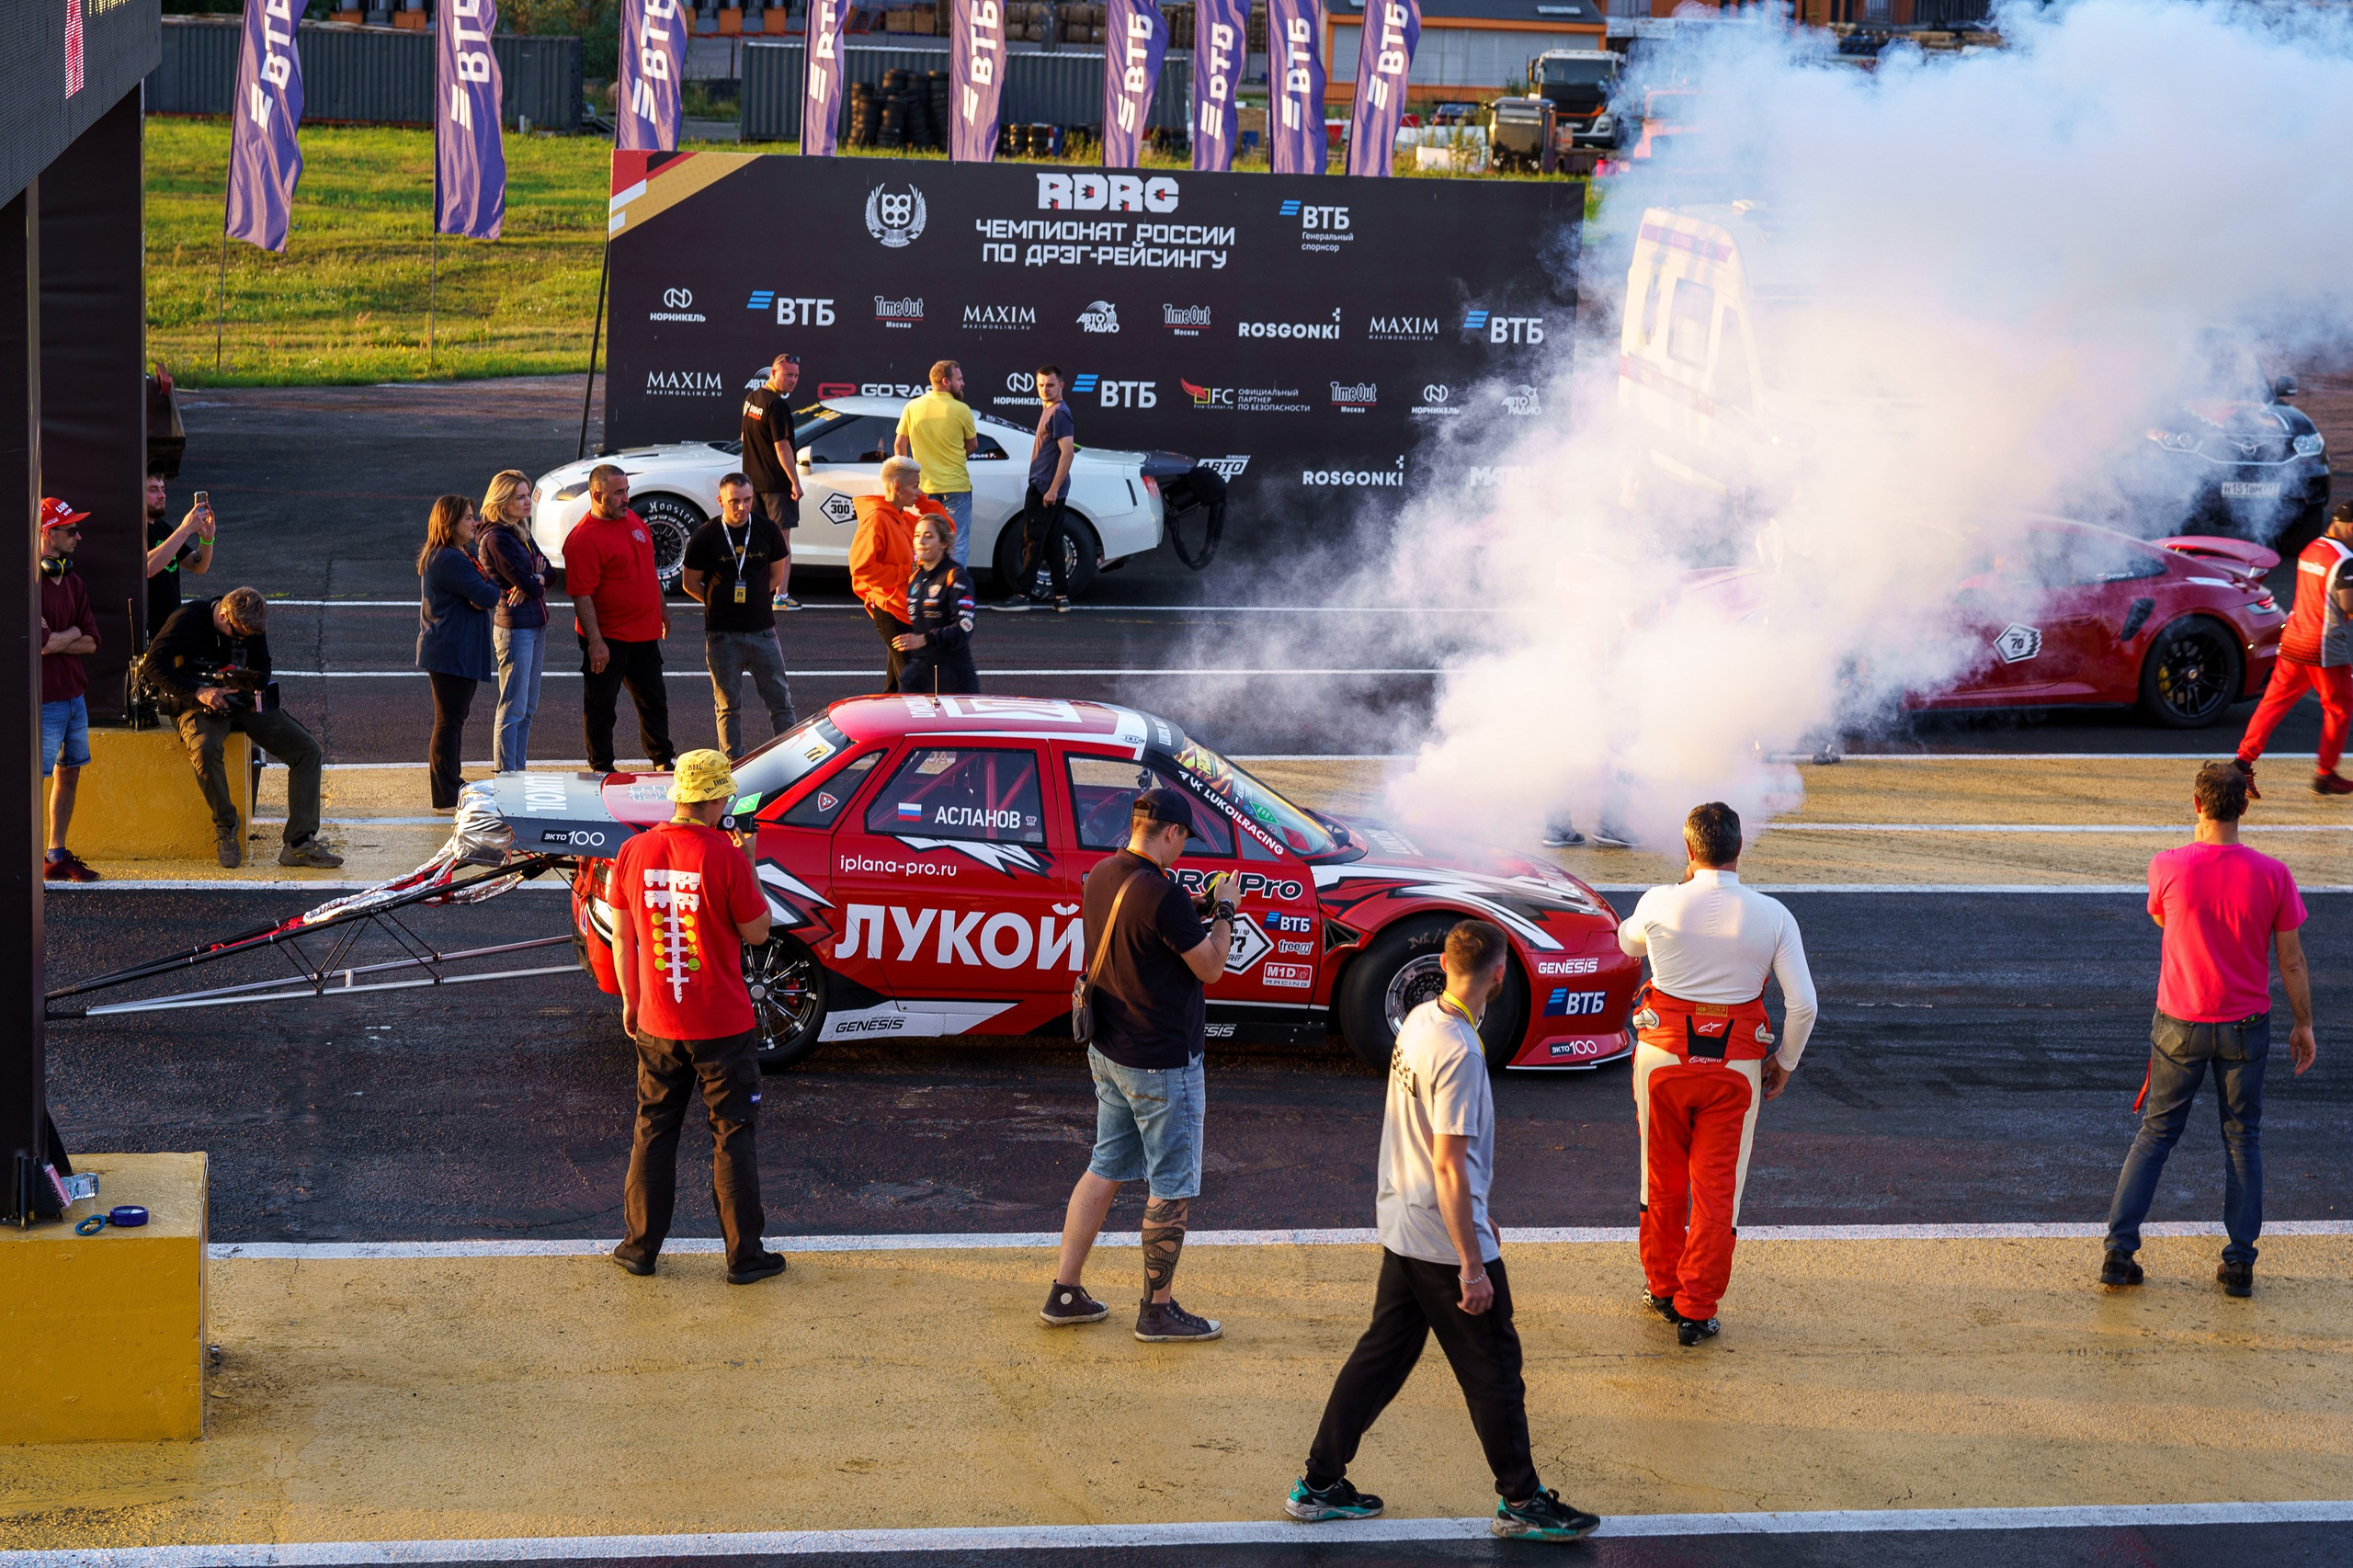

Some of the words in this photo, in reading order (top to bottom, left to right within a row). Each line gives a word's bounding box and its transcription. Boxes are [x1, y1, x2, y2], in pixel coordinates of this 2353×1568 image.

[971, 0, 998, 85] ВТБ
[1378, 3, 1409, 75] ВТБ
[1124, 12, 1154, 93] ВТБ
[1287, 17, 1311, 94] ВТБ
[1036, 173, 1179, 213] RDRC
[1302, 206, 1350, 230] ВТБ
[975, 219, 1127, 242] ЧЕМПИОНАТ
[1136, 223, 1235, 245] РОССИИ
[1302, 232, 1354, 242] Генеральный
[983, 243, 1017, 263] ПО
[1026, 241, 1227, 269] ДРЭГ-РЕЙСИНГУ
[650, 312, 706, 323] НОРНИКЕЛЬ
[777, 298, 835, 325] ВТБ
[963, 305, 1037, 324] MAXIM
[885, 321, 912, 329] Москва
[1174, 328, 1199, 336] Москва
[1238, 309, 1341, 339] ROSGONKI
[1369, 316, 1439, 334] MAXIM
[1491, 317, 1544, 344] ВТБ
[646, 370, 722, 390] MAXIM
[745, 379, 768, 390] АВТ
[861, 383, 891, 397] GO
[646, 389, 722, 397] MAXIMONLINE.RU
[1100, 381, 1157, 408] ВТБ
[1211, 389, 1234, 404] FC
[1238, 388, 1299, 396] ОФИЦИАЛЬНЫЙ
[1340, 405, 1365, 414] Москва
[1412, 406, 1460, 415] НОРНИКЕЛЬ
[1302, 458, 1404, 486] ROSGONKI
[648, 500, 695, 525] Hoosier
[831, 505, 850, 514] 300
[2011, 638, 2024, 649] 70
[935, 805, 1021, 829] АСЛАНОВ
[1203, 788, 1285, 856] LUKOILRACING
[840, 854, 957, 877] iplana-pro.ru
[1239, 871, 1303, 901] Pro
[1279, 916, 1311, 933] ВТБ
[834, 902, 1090, 972] ЛУКОЙ
[1267, 966, 1297, 978] M1D
[1538, 960, 1598, 974] GENESIS
[1565, 991, 1606, 1016] ВТБ
[835, 1019, 904, 1033] GENESIS
